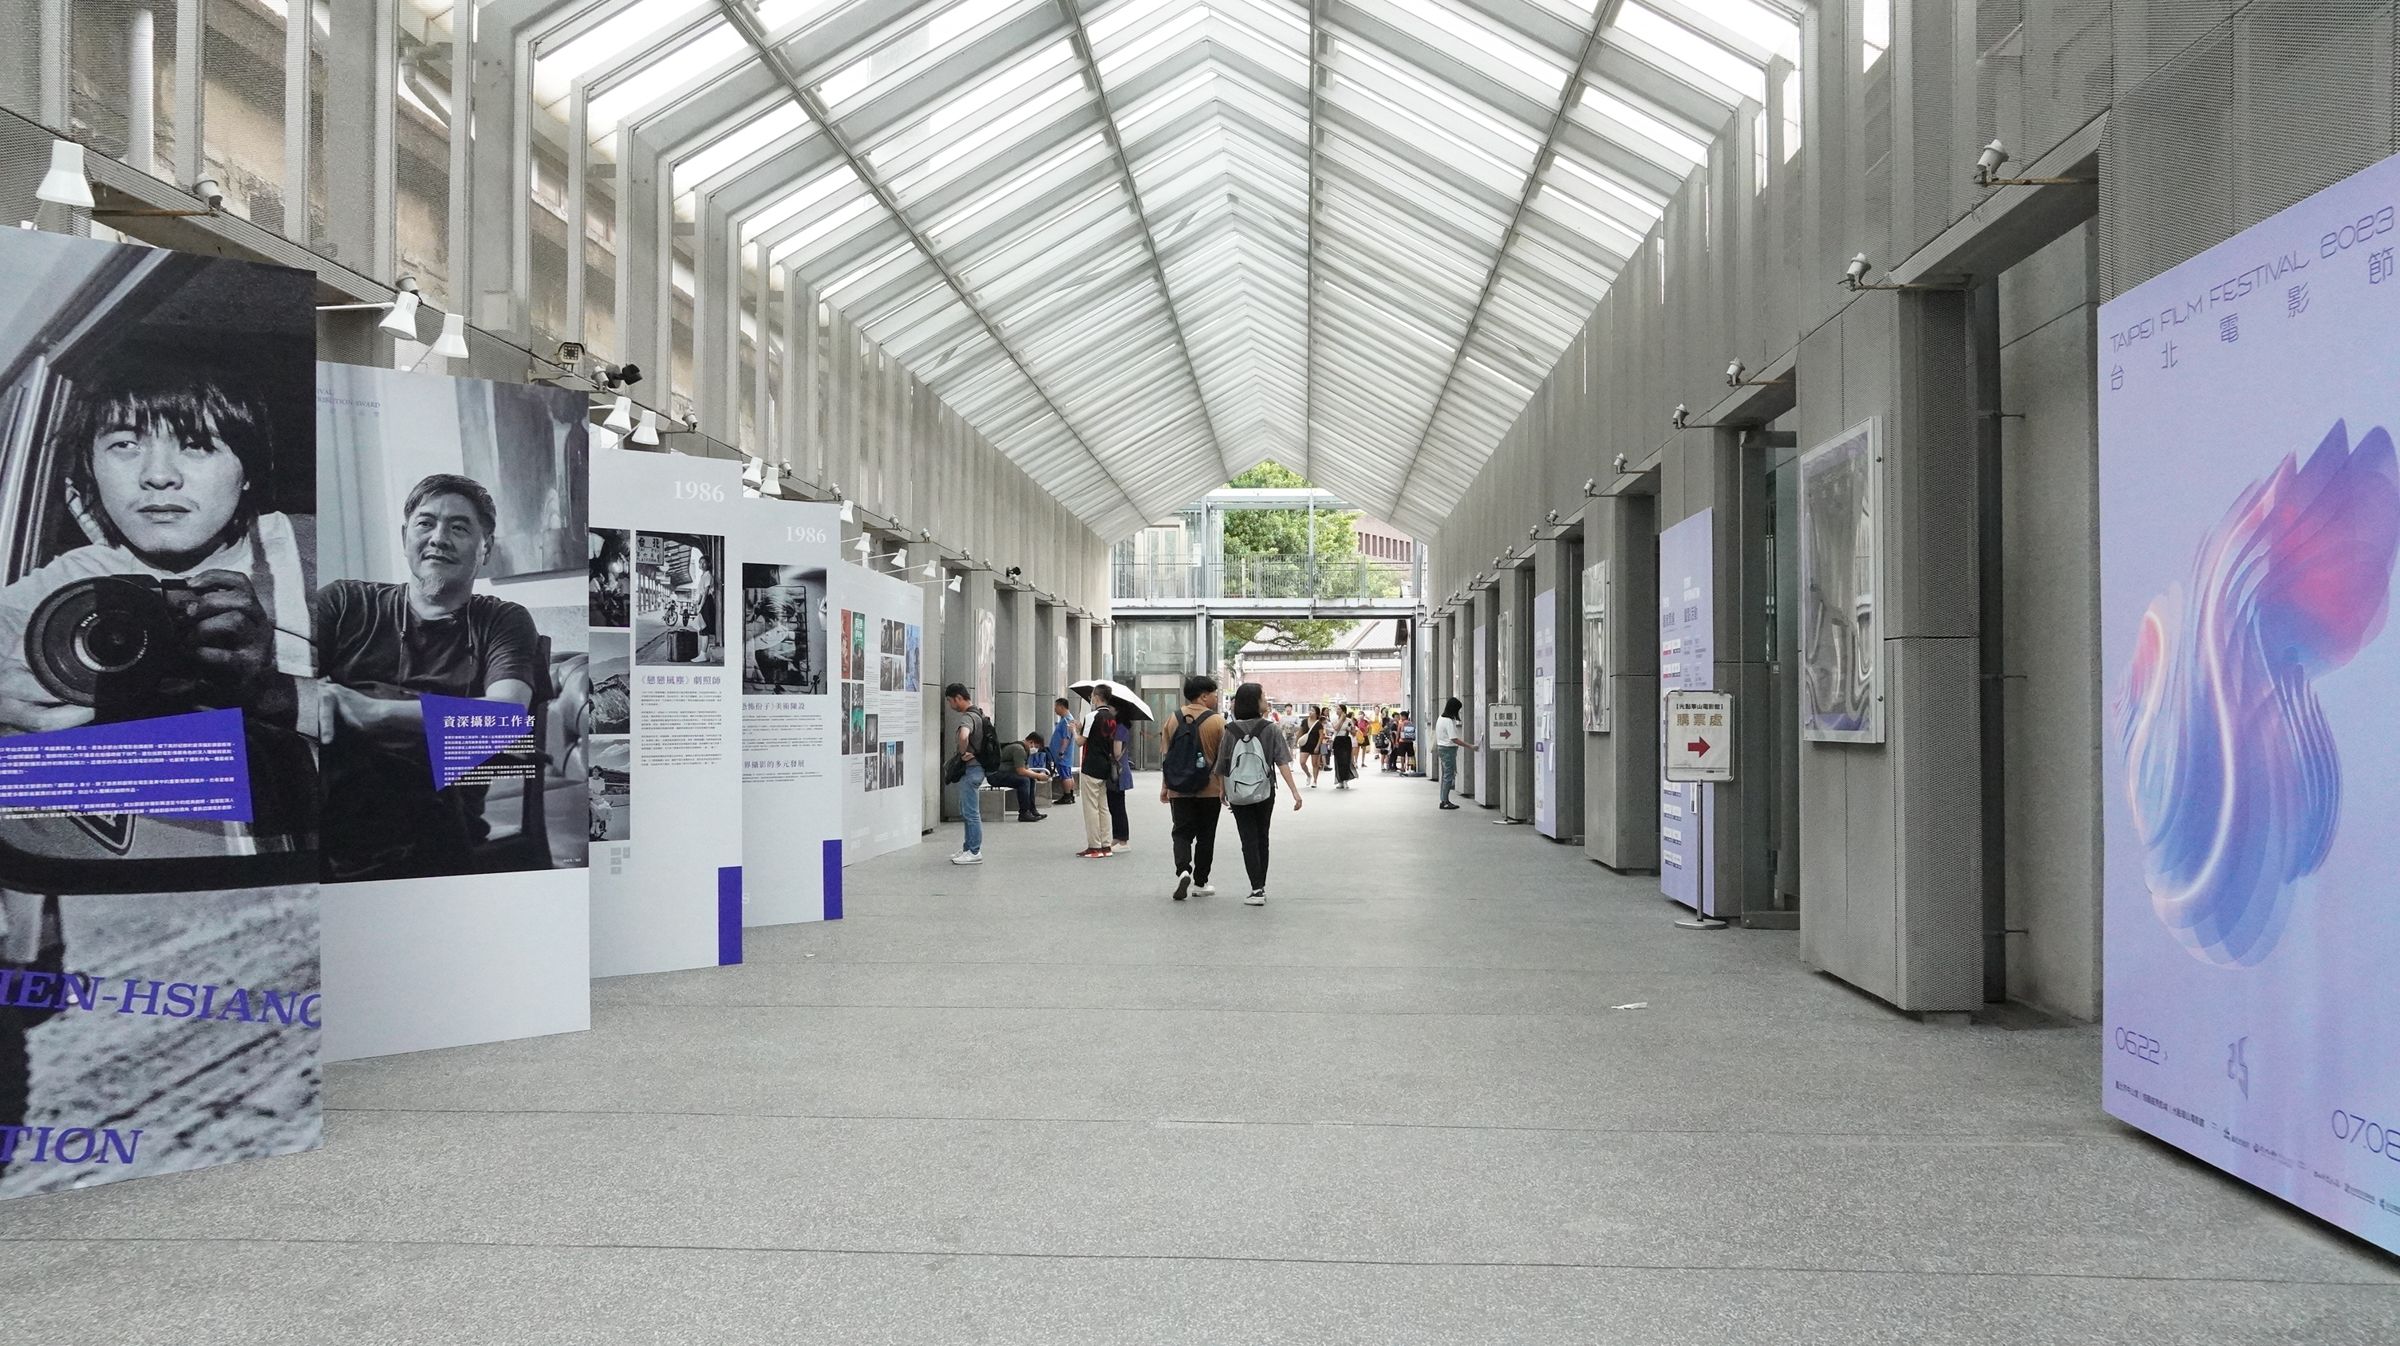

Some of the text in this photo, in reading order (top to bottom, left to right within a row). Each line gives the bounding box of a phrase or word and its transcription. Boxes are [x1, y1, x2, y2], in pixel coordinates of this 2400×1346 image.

[2110, 205, 2395, 353] TAIPEI FILM FESTIVAL 2023
[673, 480, 725, 504] 1986
[785, 526, 827, 545] 1986
[443, 715, 536, 728] 資深攝影工作者
[1676, 713, 1723, 726] 購票處
[2115, 1026, 2160, 1065] 0622
